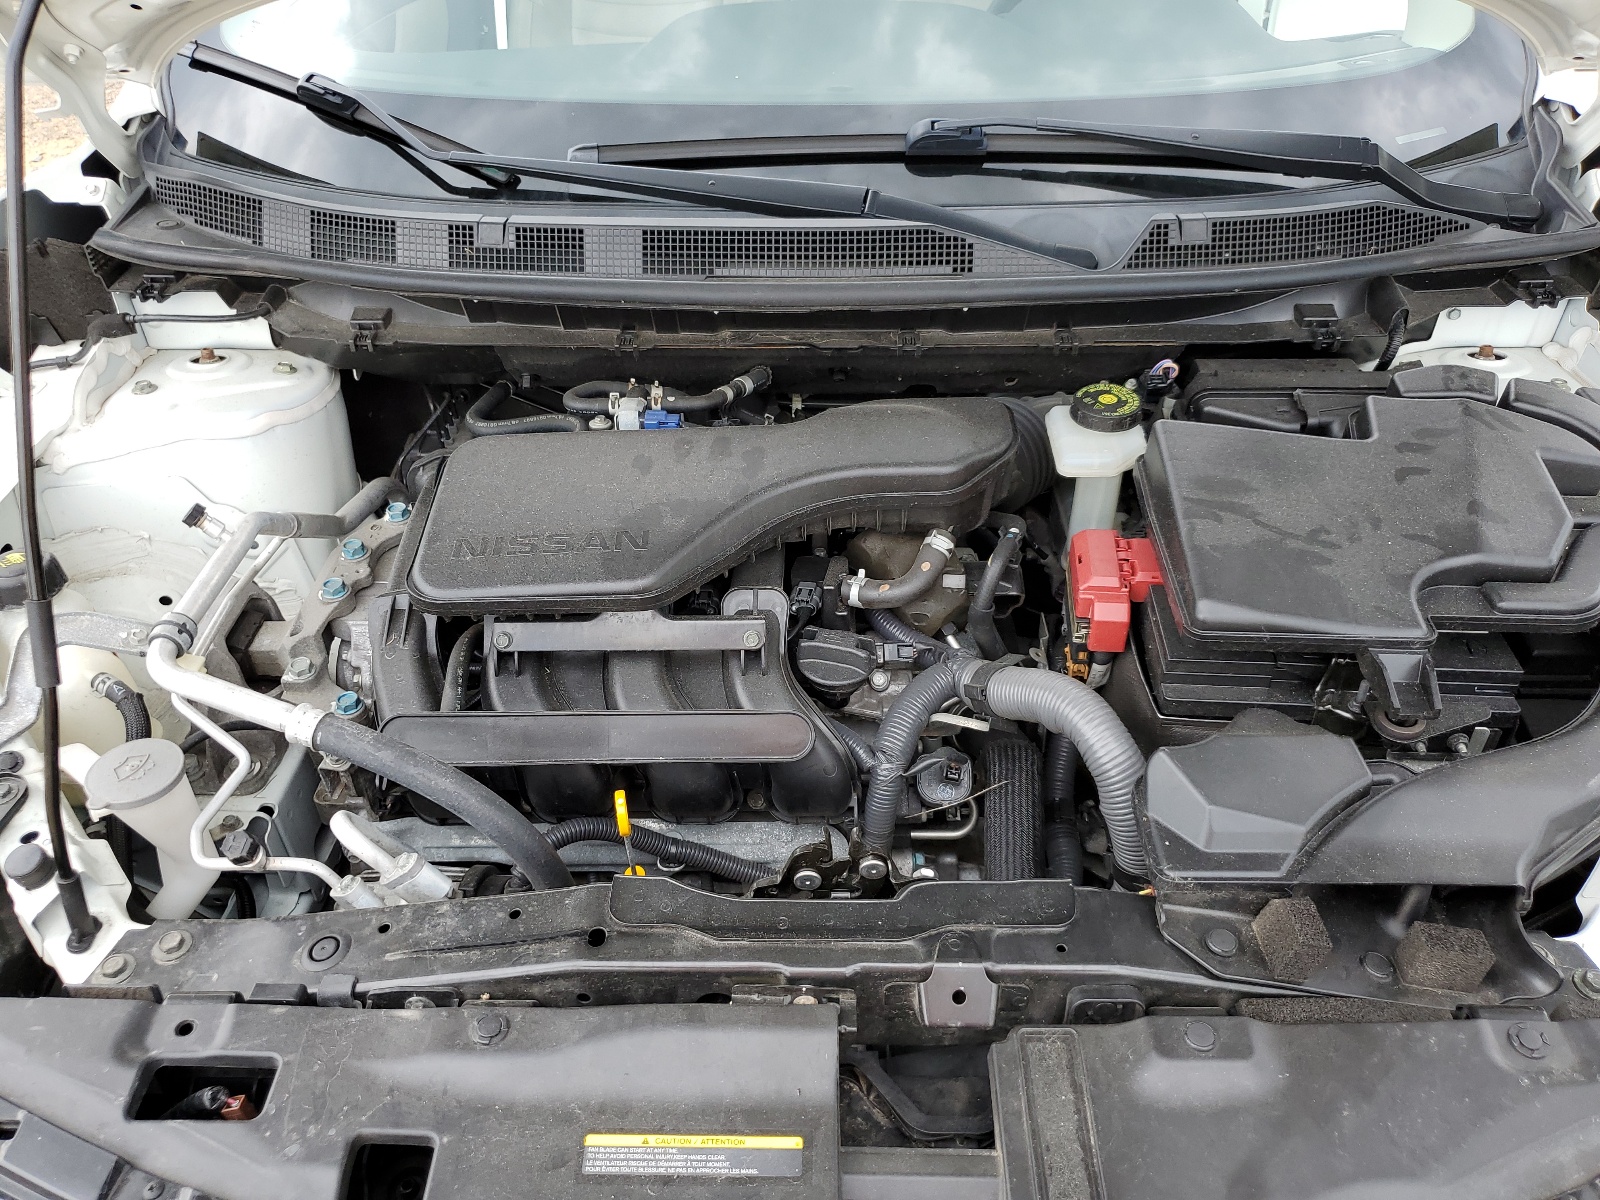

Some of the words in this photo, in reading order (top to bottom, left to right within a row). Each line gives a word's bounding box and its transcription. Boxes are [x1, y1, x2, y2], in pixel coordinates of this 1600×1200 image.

[451, 529, 650, 560] NISSAN
[655, 1137, 692, 1145] CAUTION
[701, 1138, 746, 1146] ATTENTION
